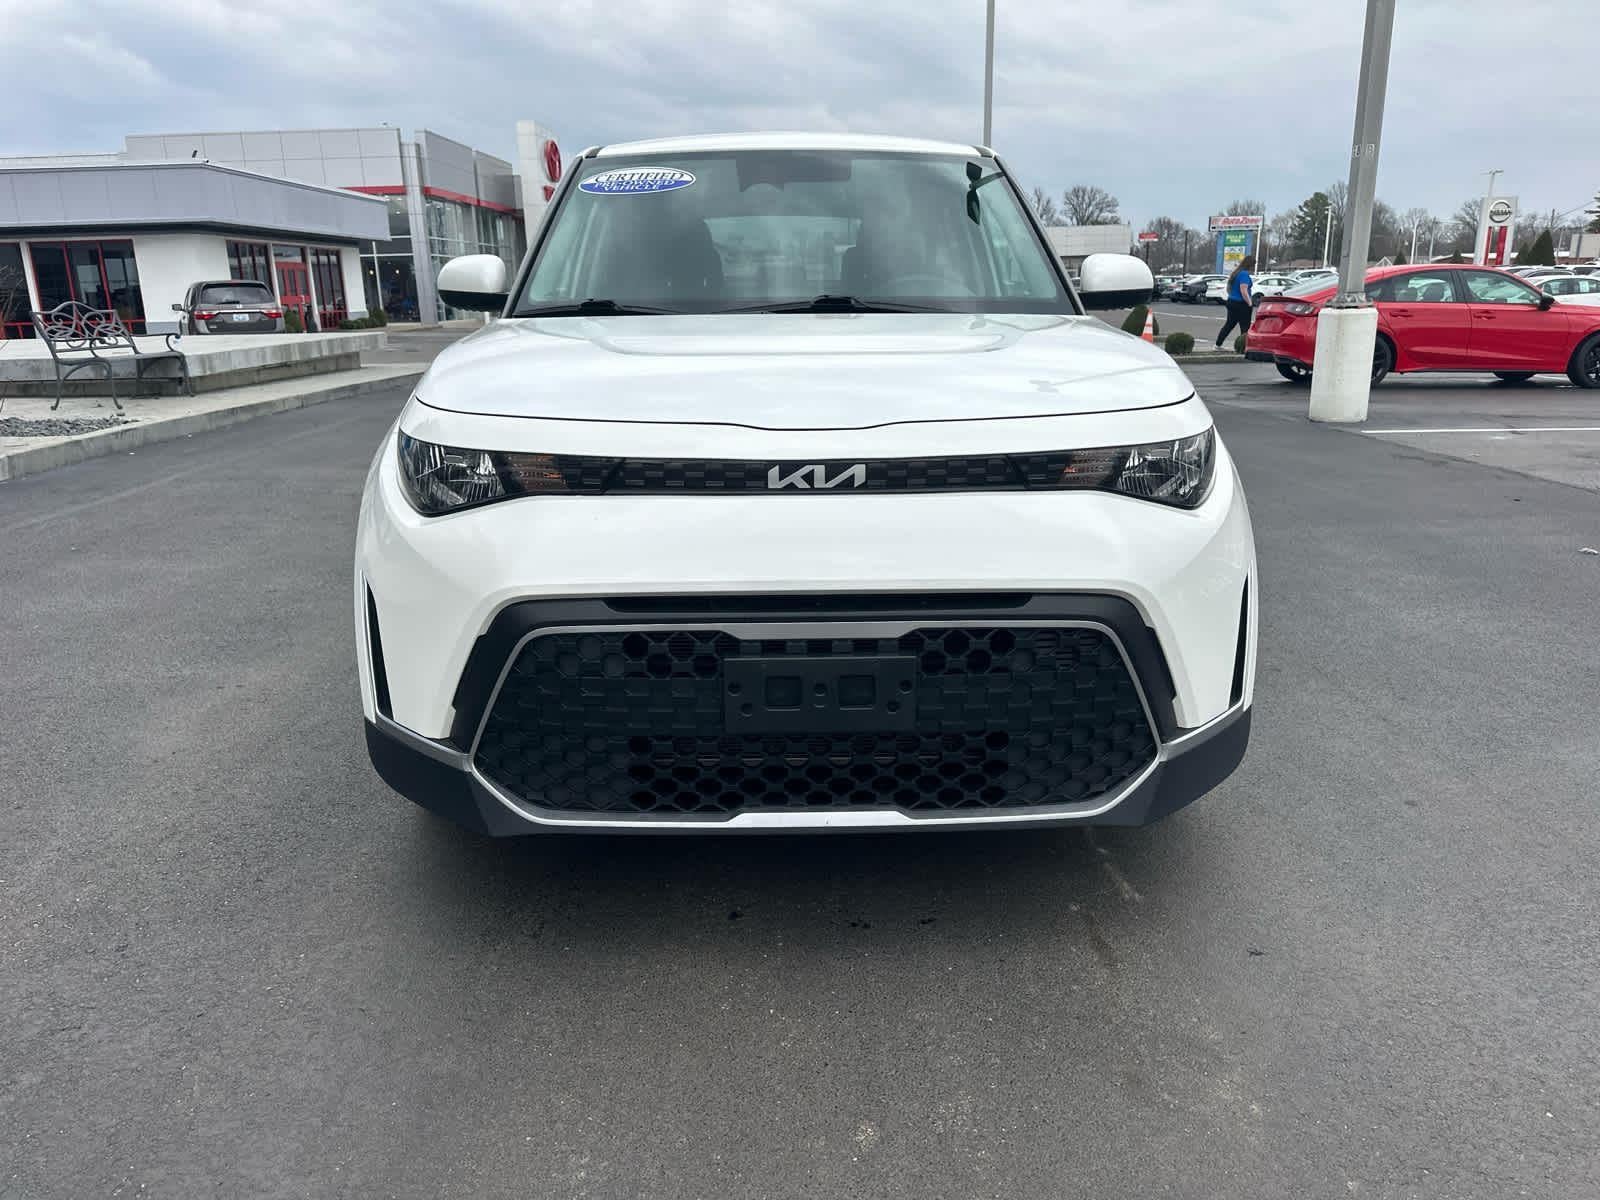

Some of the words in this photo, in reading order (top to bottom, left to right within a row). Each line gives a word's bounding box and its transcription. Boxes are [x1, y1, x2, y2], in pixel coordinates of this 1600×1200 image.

[594, 171, 684, 182] CERTIFIED
[594, 180, 676, 189] PRE-OWNED
[604, 183, 660, 191] VEHICLE
[767, 464, 866, 489] KIA
